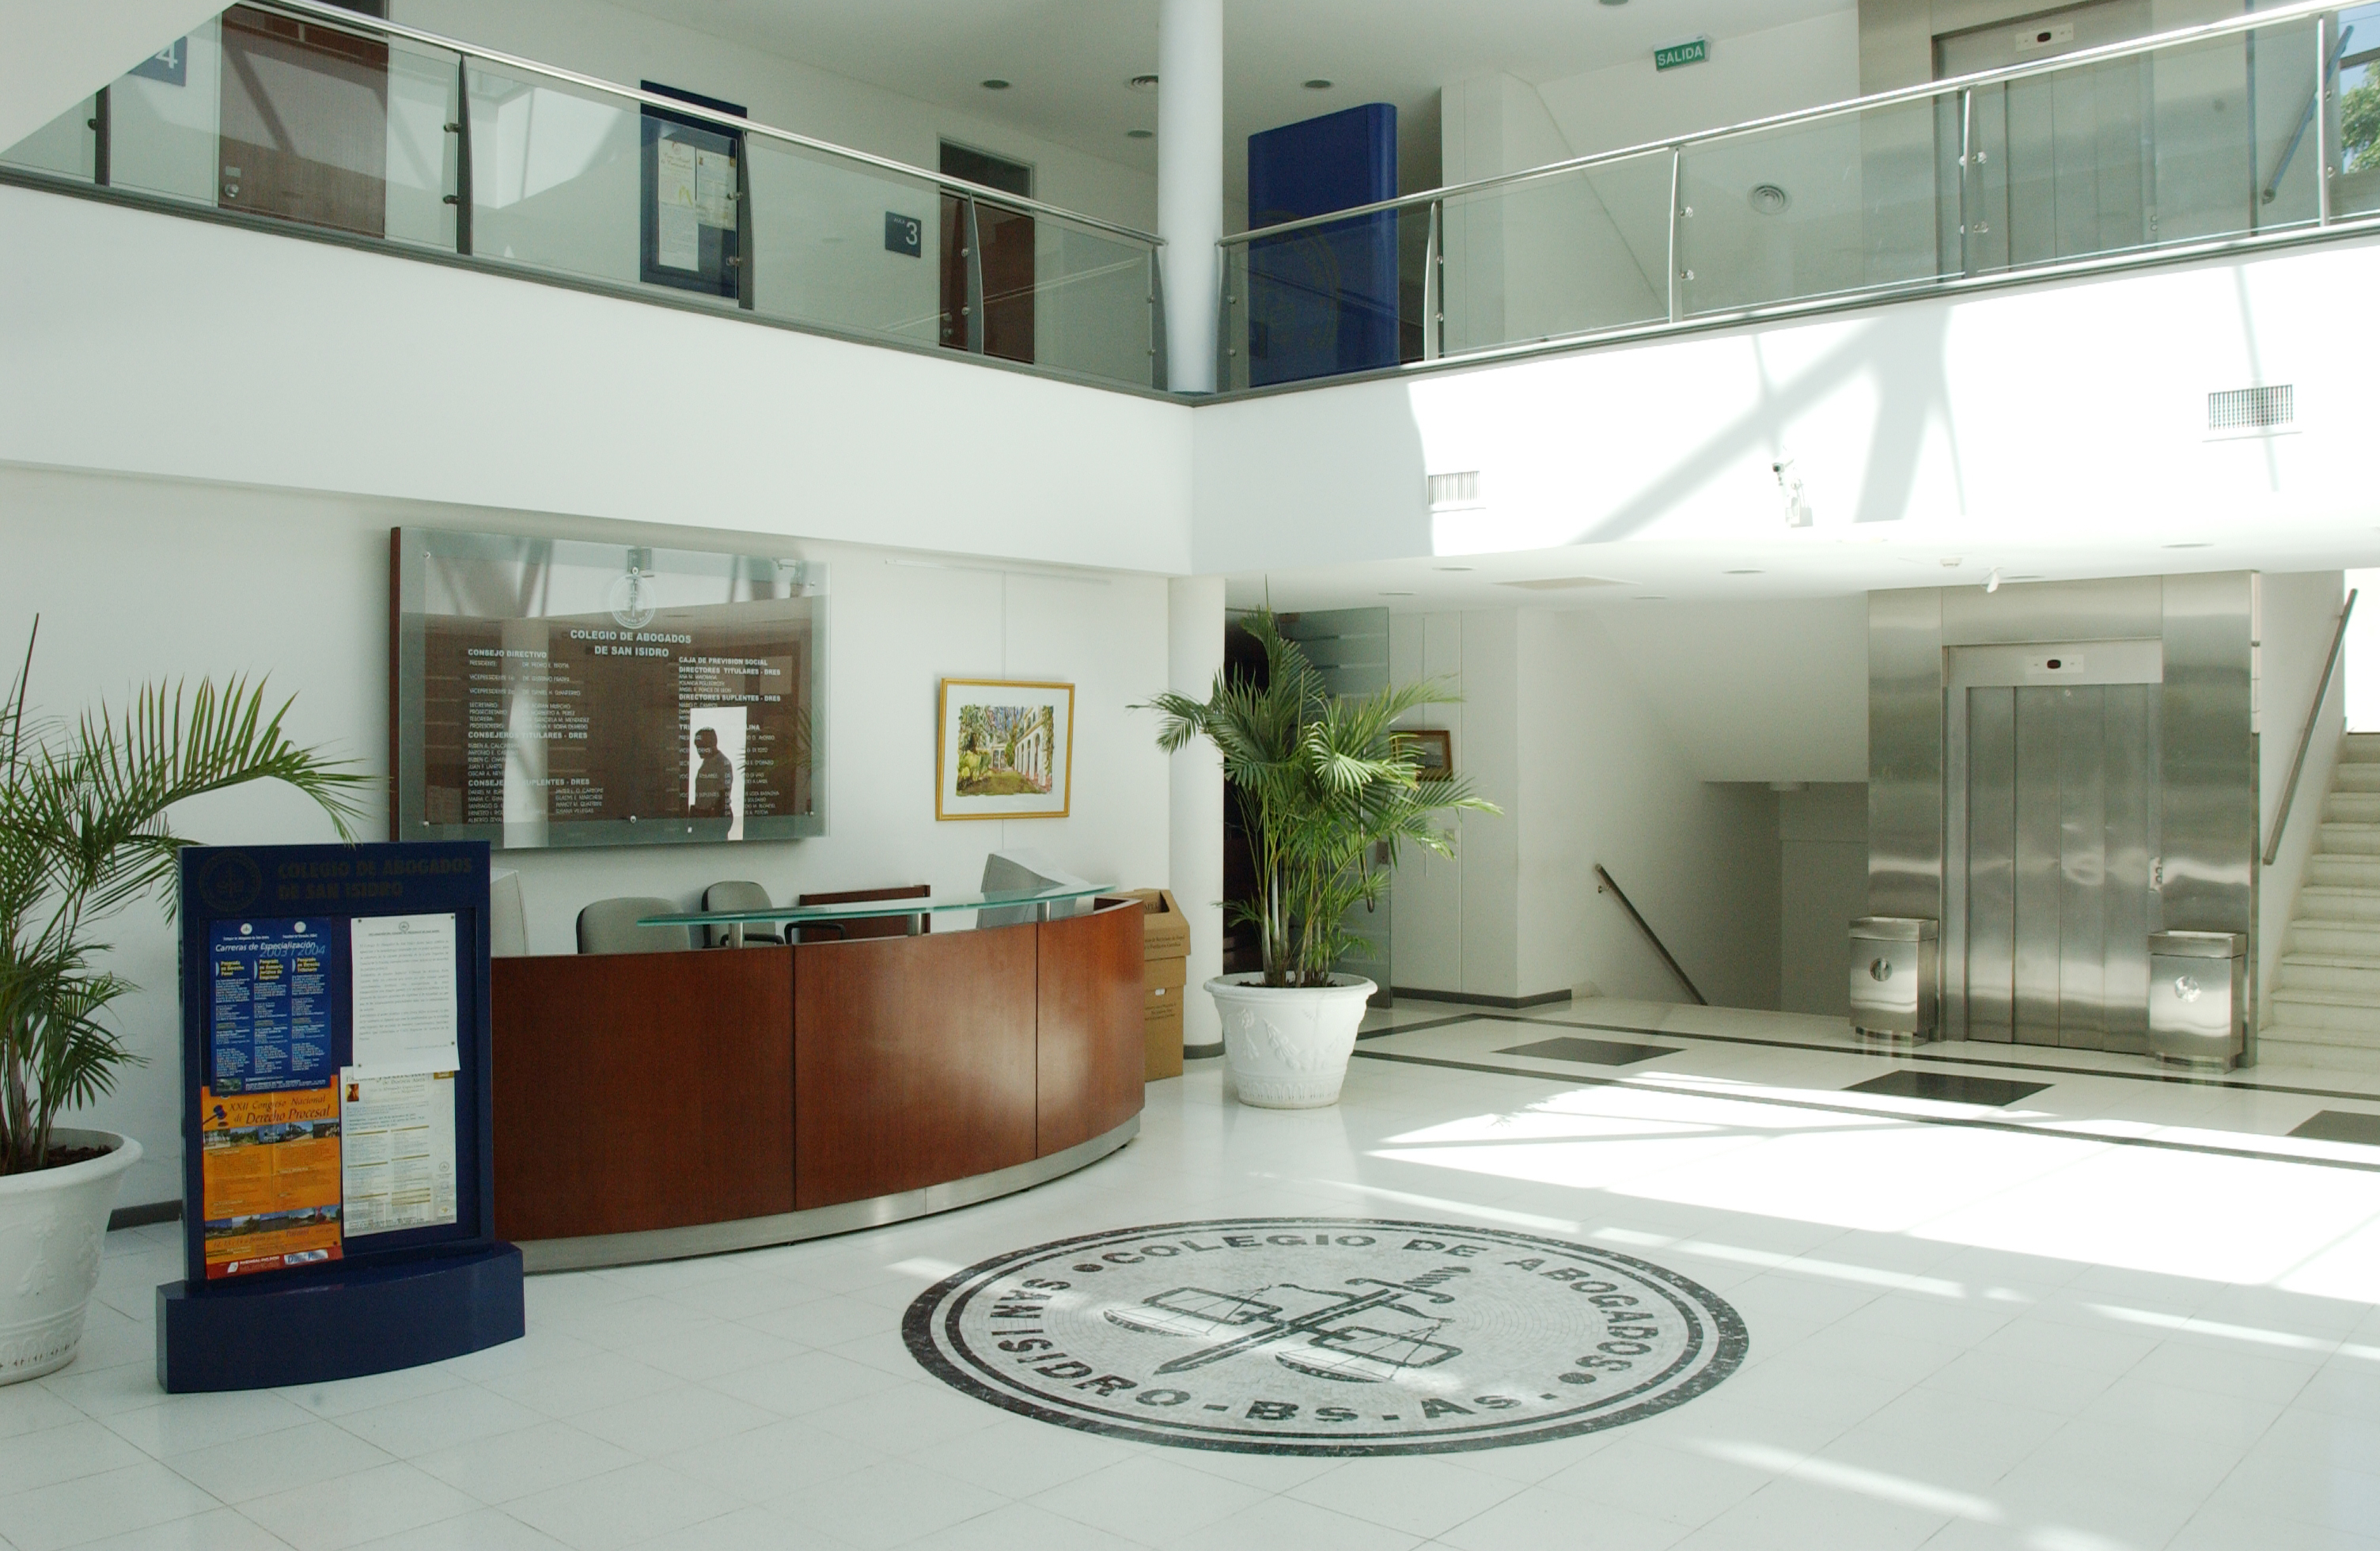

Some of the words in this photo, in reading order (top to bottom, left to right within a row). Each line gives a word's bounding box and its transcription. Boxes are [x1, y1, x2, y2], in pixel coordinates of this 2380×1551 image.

[155, 42, 178, 69] 4
[1658, 45, 1703, 66] SALIDA
[905, 222, 918, 245] 3
[570, 629, 617, 640] COLEGIO
[620, 631, 633, 641] DE
[636, 632, 692, 643] ABOGADOS
[506, 650, 548, 658] DIRECTIVO
[594, 645, 608, 655] DE
[611, 646, 632, 656] SAN
[635, 647, 669, 658] ISIDRO
[278, 861, 351, 879] COLEGIO
[382, 858, 472, 875] ABOGADOS
[305, 882, 339, 900] SAN
[345, 881, 404, 898] ISIDRO
[215, 943, 247, 952] Carreras
[248, 942, 259, 950] de
[260, 941, 316, 951] Especialización
[260, 947, 287, 958] 2003
[298, 945, 326, 957] 2004
[229, 1102, 249, 1112] XXII
[252, 1100, 286, 1113] Congreso
[290, 1094, 326, 1106] Nacional
[245, 1109, 286, 1124] Derecho
[288, 1104, 331, 1121] Procesal
[990, 1278, 1071, 1319] SAN
[1102, 1234, 1377, 1265] COLEGIO
[1402, 1238, 1489, 1258] DE
[1503, 1257, 1659, 1372] ABOGADOS
[991, 1329, 1192, 1407] ISIDRO
